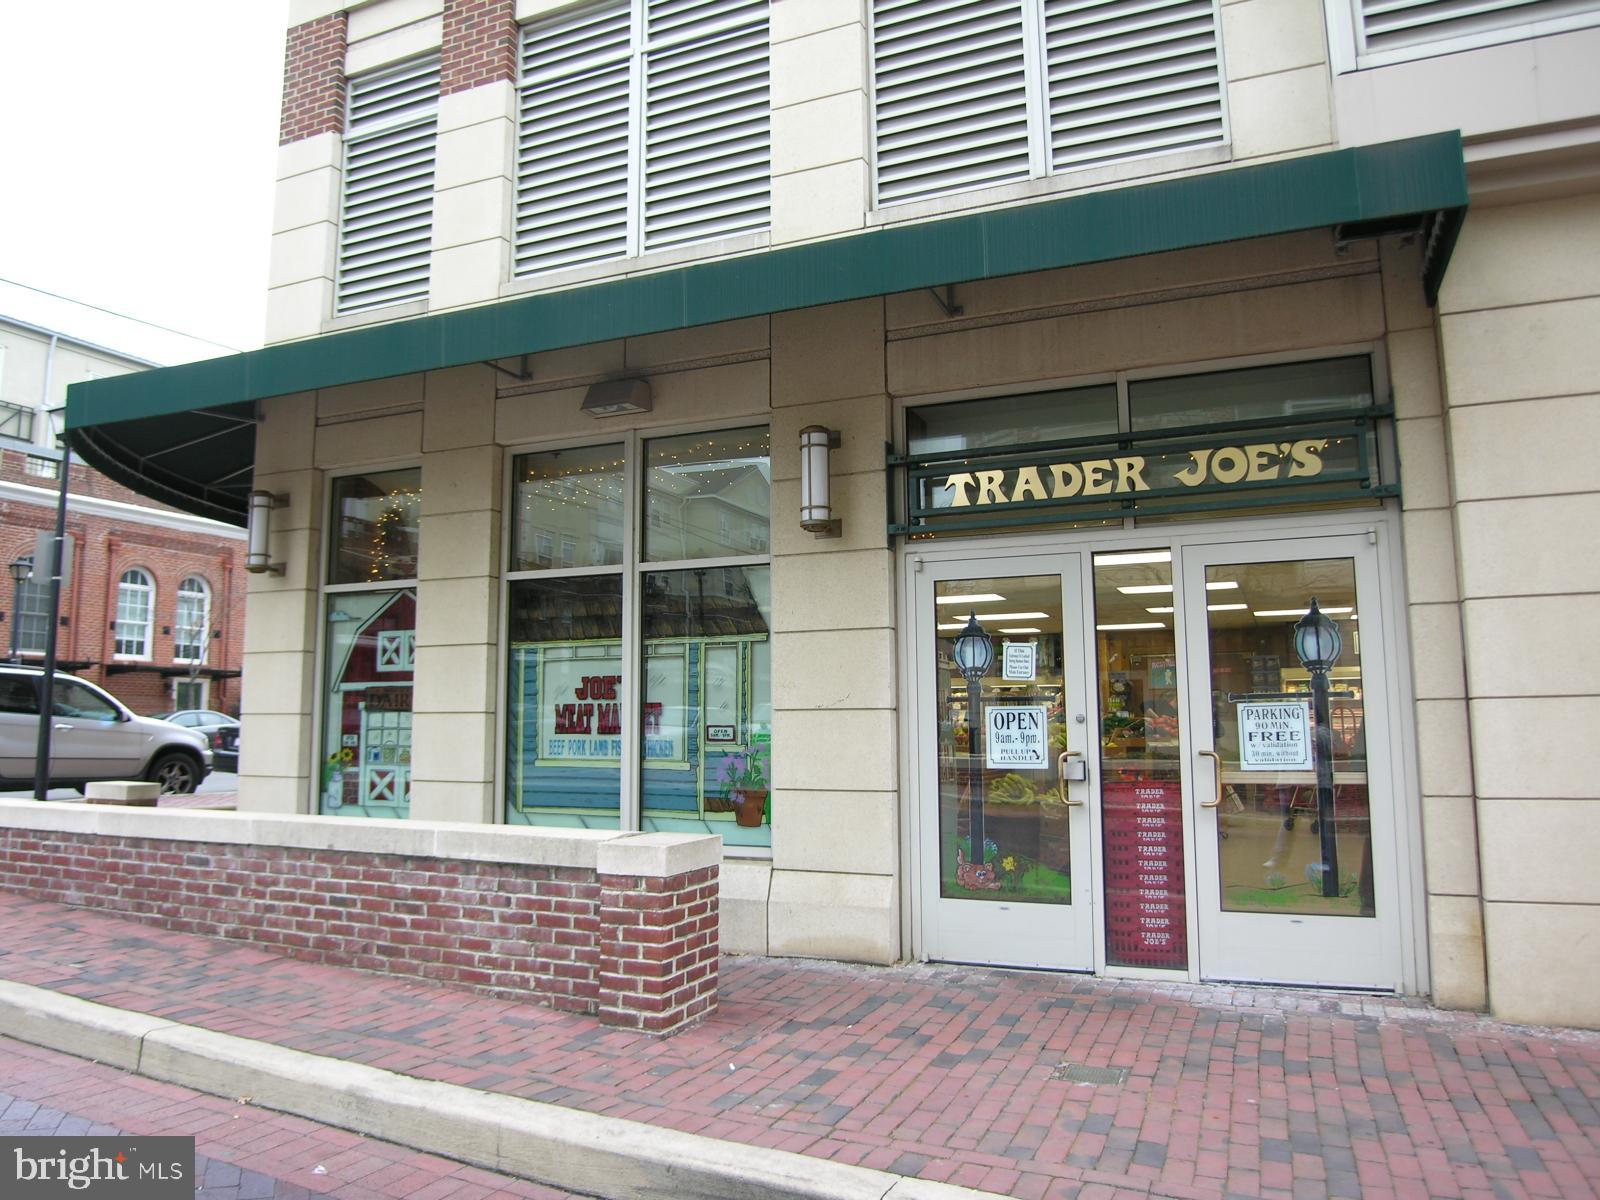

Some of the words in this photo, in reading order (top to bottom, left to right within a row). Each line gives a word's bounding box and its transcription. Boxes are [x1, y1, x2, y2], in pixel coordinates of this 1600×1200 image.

[945, 456, 1150, 507] TRADER
[1173, 439, 1328, 487] JOE'S
[575, 675, 622, 701] JOE'
[370, 693, 409, 707] DAIR
[554, 702, 594, 735] MEAT
[597, 702, 664, 736] MAET
[994, 712, 1039, 731] OPEN
[1246, 708, 1300, 720] PARKING
[1255, 722, 1268, 730] 90
[1270, 722, 1293, 730] MIN.
[1248, 730, 1301, 742] FREE
[548, 739, 565, 756] BEEF
[611, 740, 622, 757] FIS
